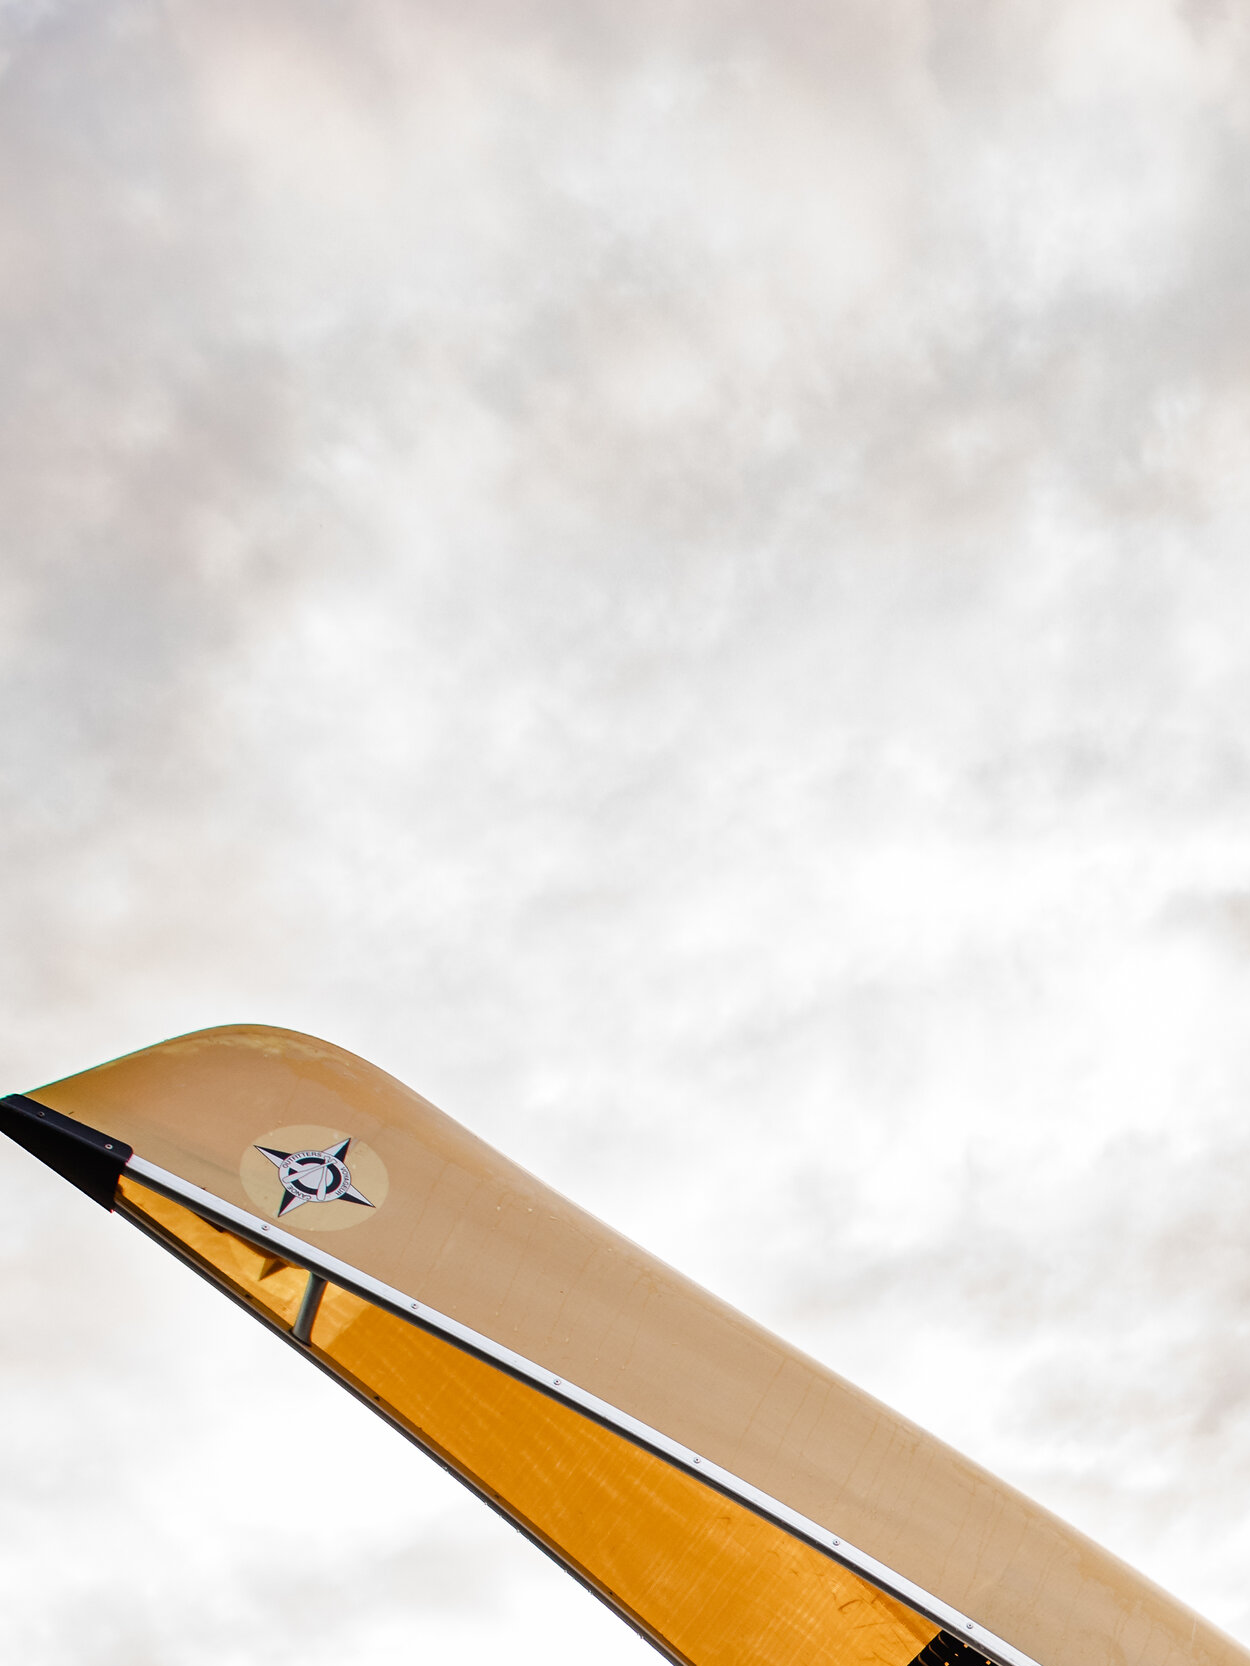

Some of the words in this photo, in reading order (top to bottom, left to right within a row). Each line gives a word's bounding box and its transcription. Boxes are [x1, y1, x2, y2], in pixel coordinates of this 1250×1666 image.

[282, 1151, 322, 1169] OUTFITTERS
[335, 1166, 350, 1196] VOYAGEUR
[287, 1183, 312, 1201] CANOE
